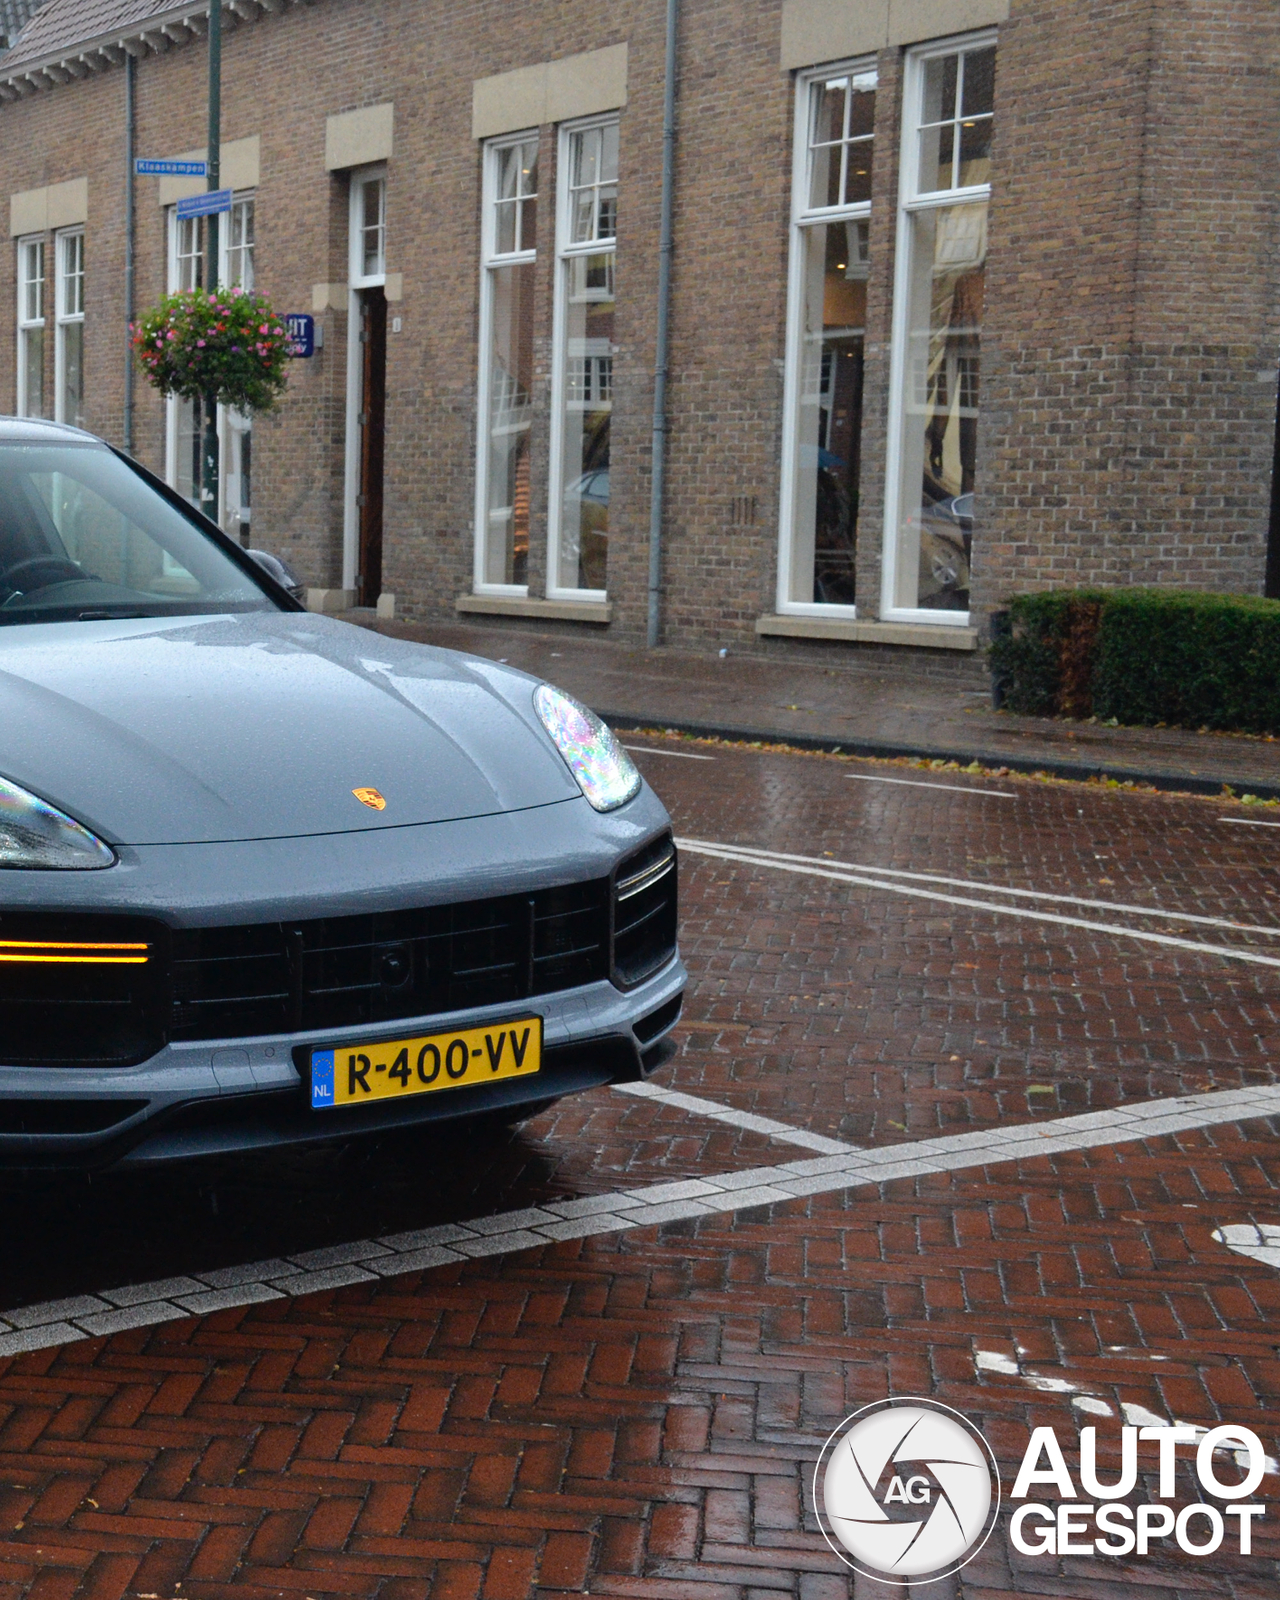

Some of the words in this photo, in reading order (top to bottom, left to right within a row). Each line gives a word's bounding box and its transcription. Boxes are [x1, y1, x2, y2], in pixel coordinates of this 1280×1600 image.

[138, 162, 204, 174] Klaaskampen
[348, 1027, 531, 1095] R-400-VV
[314, 1085, 331, 1098] NL
